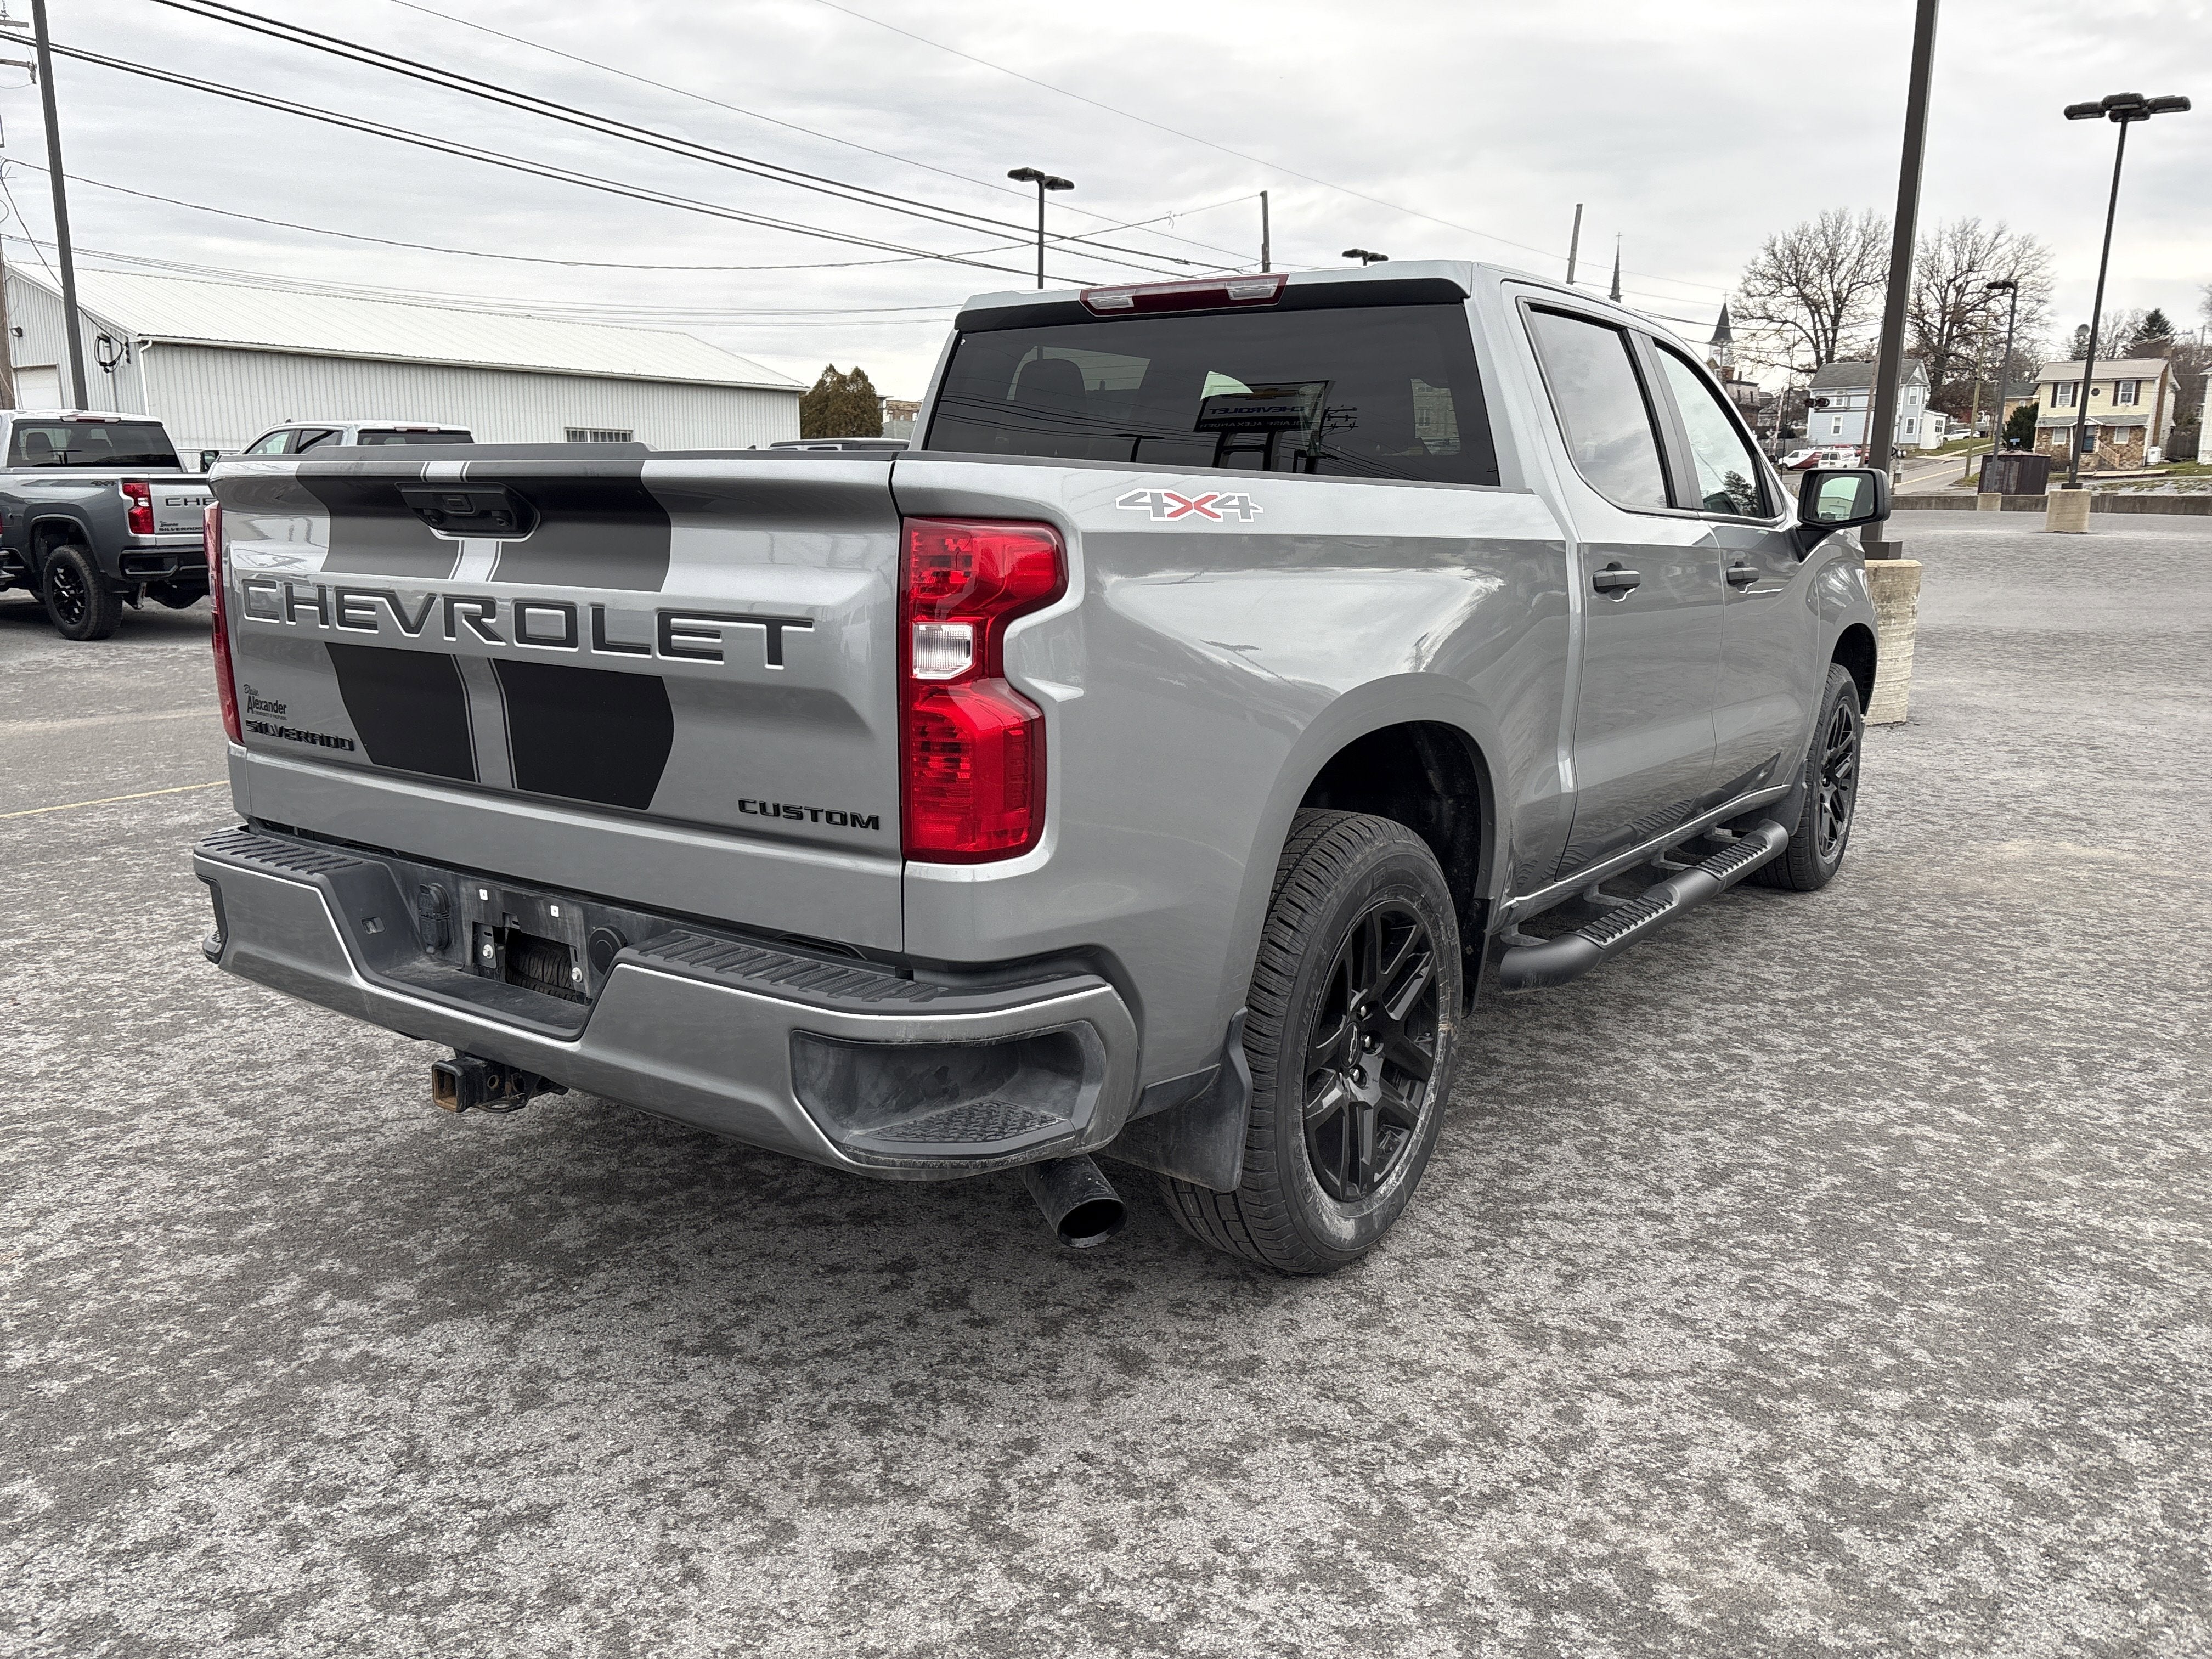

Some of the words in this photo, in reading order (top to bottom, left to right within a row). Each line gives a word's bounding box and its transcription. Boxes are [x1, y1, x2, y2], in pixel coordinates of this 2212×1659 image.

[241, 579, 814, 669] CHEVROLET
[247, 695, 287, 715] Alexander
[245, 719, 354, 752] SILVERADO
[738, 798, 880, 831] CUSTOM
